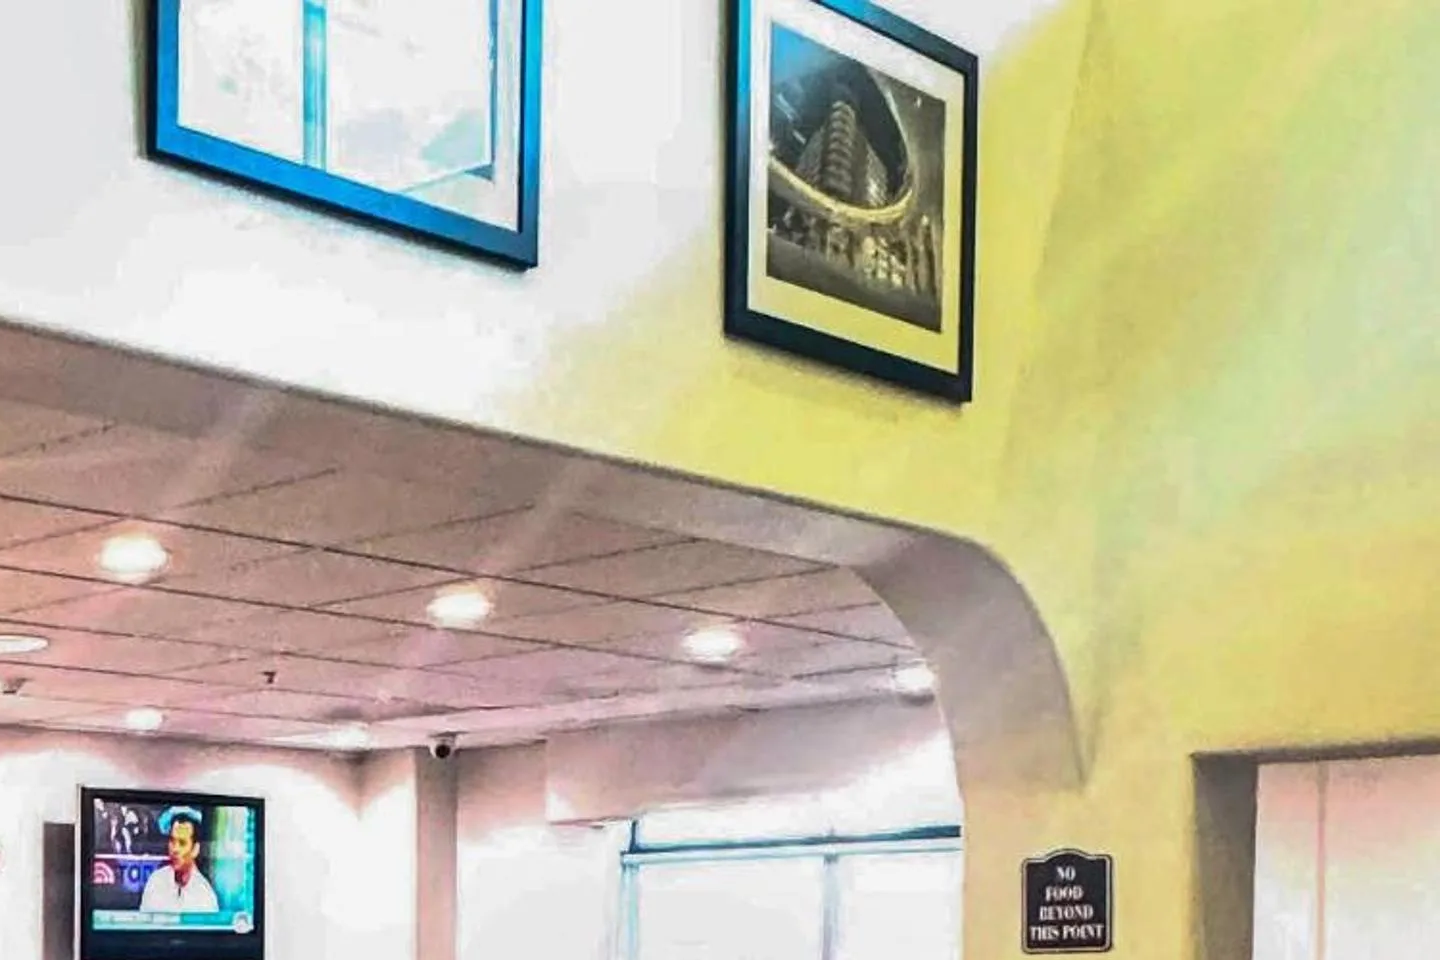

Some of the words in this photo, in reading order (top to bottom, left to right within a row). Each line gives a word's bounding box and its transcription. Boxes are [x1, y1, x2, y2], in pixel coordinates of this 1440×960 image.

[1056, 865, 1076, 881] NO
[1045, 885, 1084, 901] FOOD
[1039, 904, 1094, 920] BEYOND
[1030, 925, 1059, 940] THIS
[1063, 923, 1104, 939] POINT
